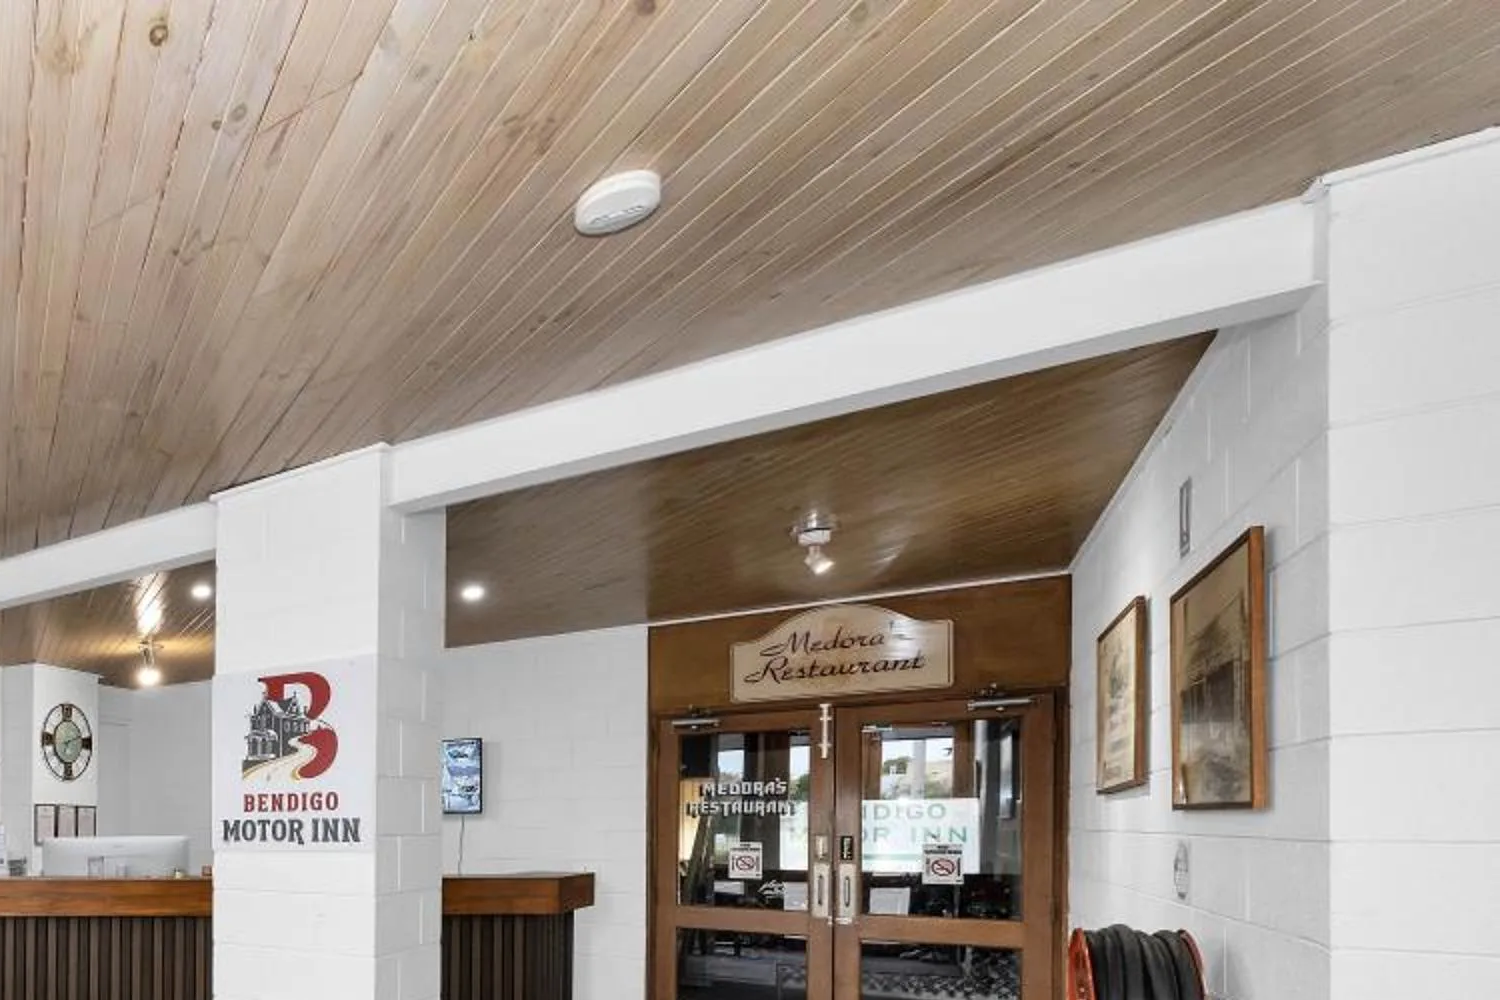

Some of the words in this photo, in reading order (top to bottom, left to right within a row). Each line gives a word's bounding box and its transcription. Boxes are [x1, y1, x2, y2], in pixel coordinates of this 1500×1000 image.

[743, 650, 927, 685] Restaurant
[243, 791, 339, 813] BENDIGO
[862, 803, 948, 820] DIGO
[222, 819, 305, 845] MOTOR
[311, 817, 361, 842] INN
